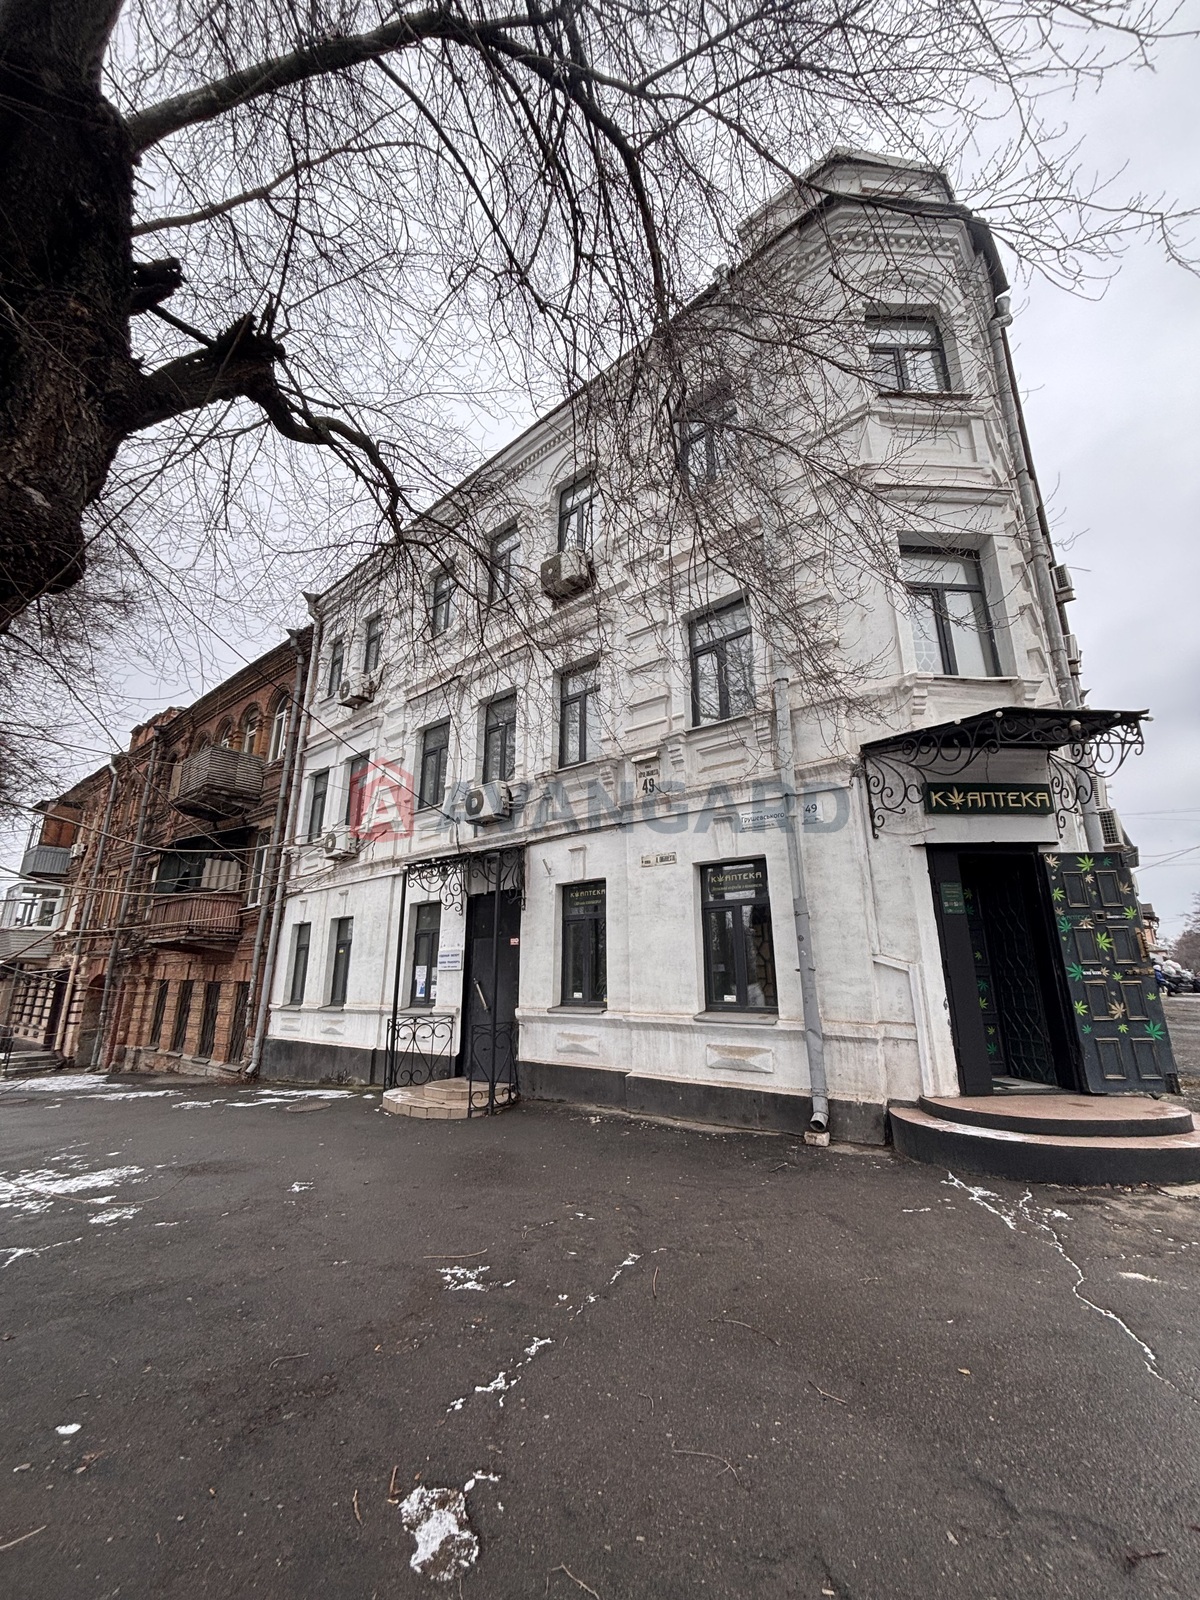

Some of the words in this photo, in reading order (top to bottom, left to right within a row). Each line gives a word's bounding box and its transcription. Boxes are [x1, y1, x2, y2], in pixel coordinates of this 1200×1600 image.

[642, 777, 655, 794] 49
[805, 803, 818, 813] 49
[741, 812, 785, 824] Грушевського
